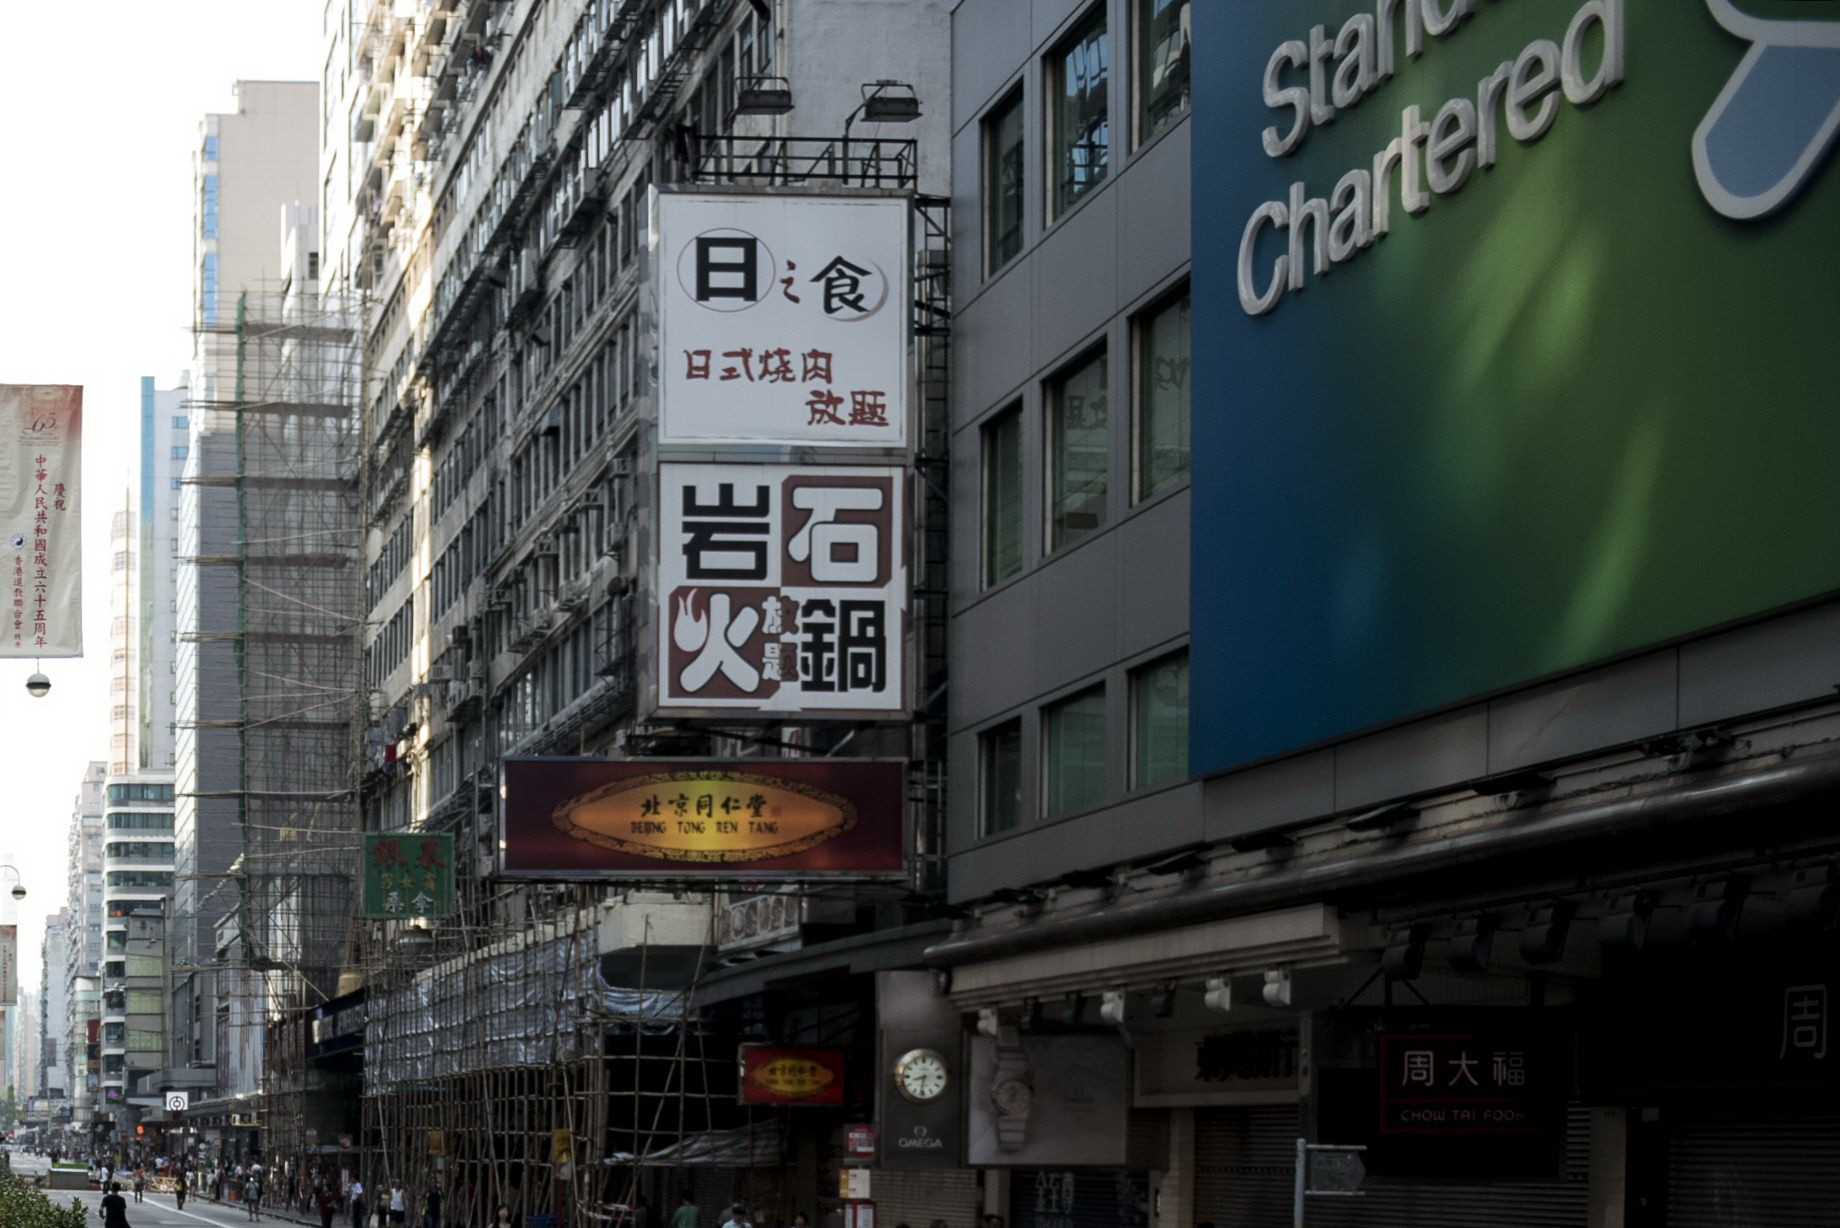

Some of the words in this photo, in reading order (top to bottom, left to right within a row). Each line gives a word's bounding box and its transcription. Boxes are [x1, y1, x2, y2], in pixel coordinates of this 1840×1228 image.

[1263, 0, 1498, 157] Stan
[1237, 0, 1625, 316] Chartered
[696, 236, 874, 315] 日之食
[53, 482, 67, 512] 慶祝
[32, 454, 49, 649] 中華人民共和國成立六十五周年
[640, 793, 768, 818] 北京同仁堂
[630, 821, 667, 835] BEIJING
[677, 821, 706, 834] TONG
[716, 821, 738, 834] REN
[748, 820, 779, 834] TANG
[1778, 984, 1829, 1060] 周
[1401, 1049, 1527, 1088] 周大福
[1400, 1109, 1447, 1122] CHOW
[1451, 1109, 1477, 1121] TAI
[898, 1137, 943, 1149] OMEGA
